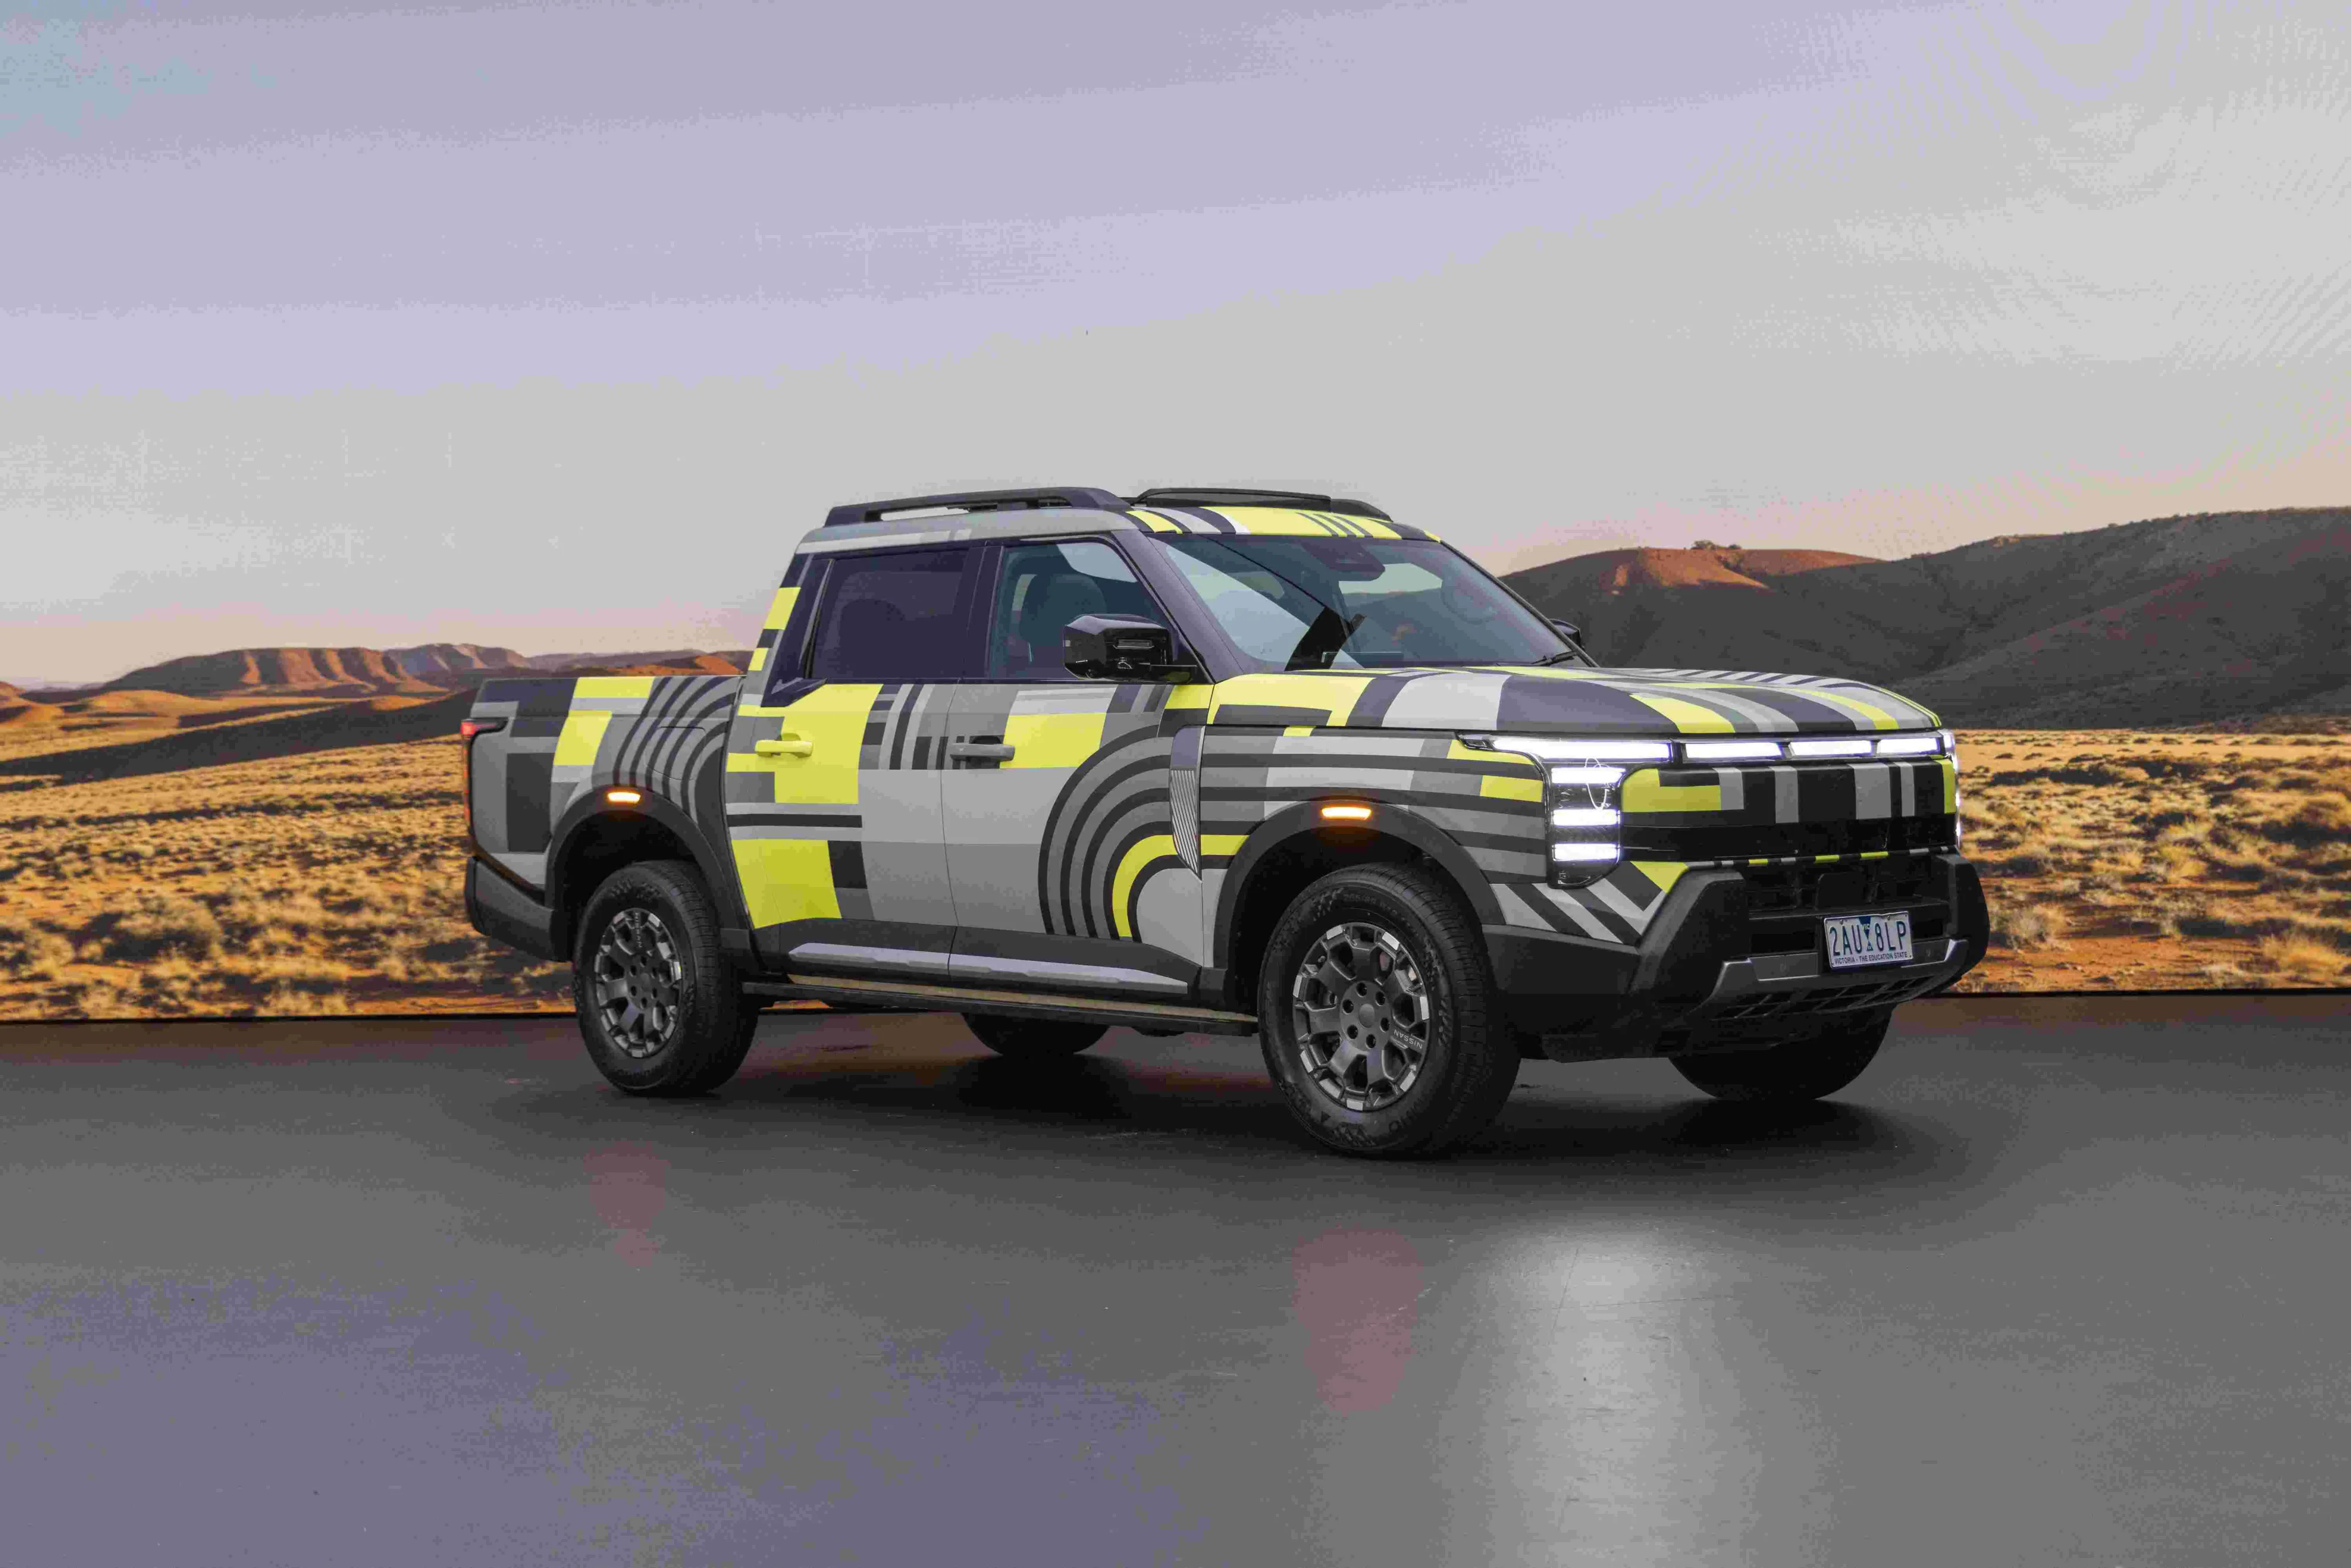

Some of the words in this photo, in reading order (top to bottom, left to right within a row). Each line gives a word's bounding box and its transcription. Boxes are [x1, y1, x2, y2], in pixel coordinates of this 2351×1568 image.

[1830, 924, 1862, 956] 2AU
[1875, 920, 1906, 951] 8LP
[1859, 954, 1868, 963] THE
[1868, 952, 1893, 961] EDUCATION
[1394, 1029, 1422, 1049] NISSAN
